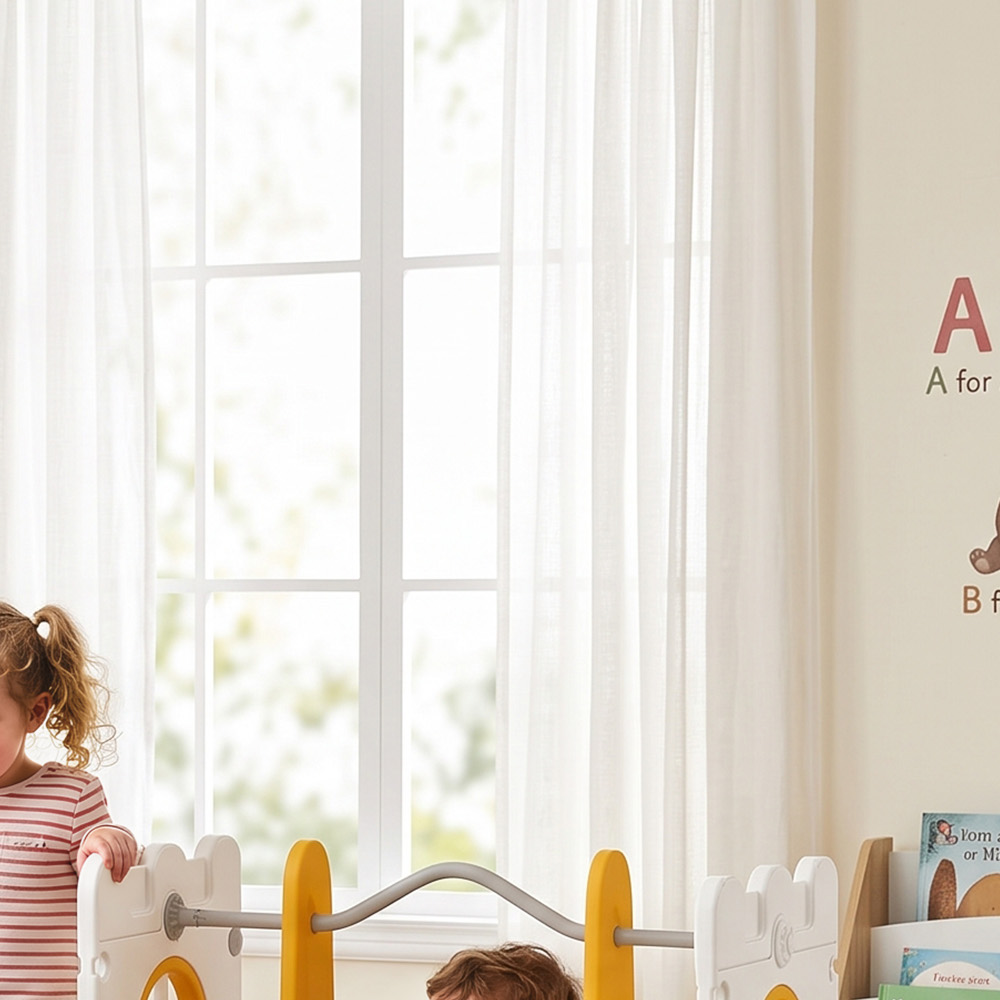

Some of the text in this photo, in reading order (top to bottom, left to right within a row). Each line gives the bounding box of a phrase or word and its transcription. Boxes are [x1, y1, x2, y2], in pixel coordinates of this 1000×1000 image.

[933, 276, 993, 354] A
[925, 365, 992, 395] A for
[963, 585, 982, 614] B
[963, 850, 979, 861] or
